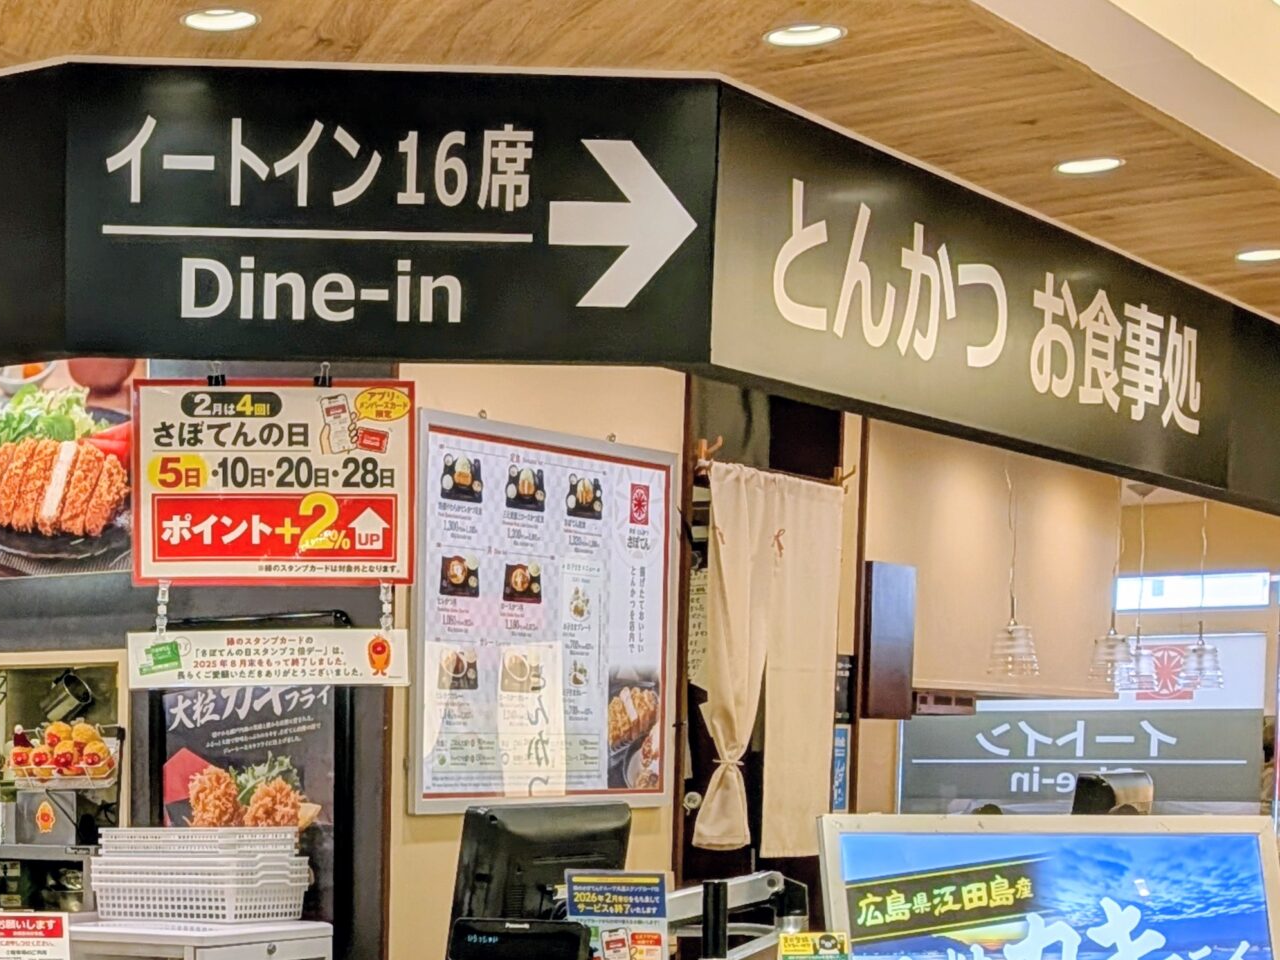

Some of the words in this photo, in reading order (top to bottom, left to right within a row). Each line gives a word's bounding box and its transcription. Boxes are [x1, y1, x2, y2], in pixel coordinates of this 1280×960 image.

[106, 115, 534, 211] イートイン16席
[180, 255, 462, 324] Dine-in
[773, 178, 1008, 368] とんかつ
[1030, 271, 1200, 435] お食事処
[152, 421, 310, 448] さぼてんの日
[358, 532, 381, 547] UP
[857, 874, 1035, 928] 広島県江田島産
